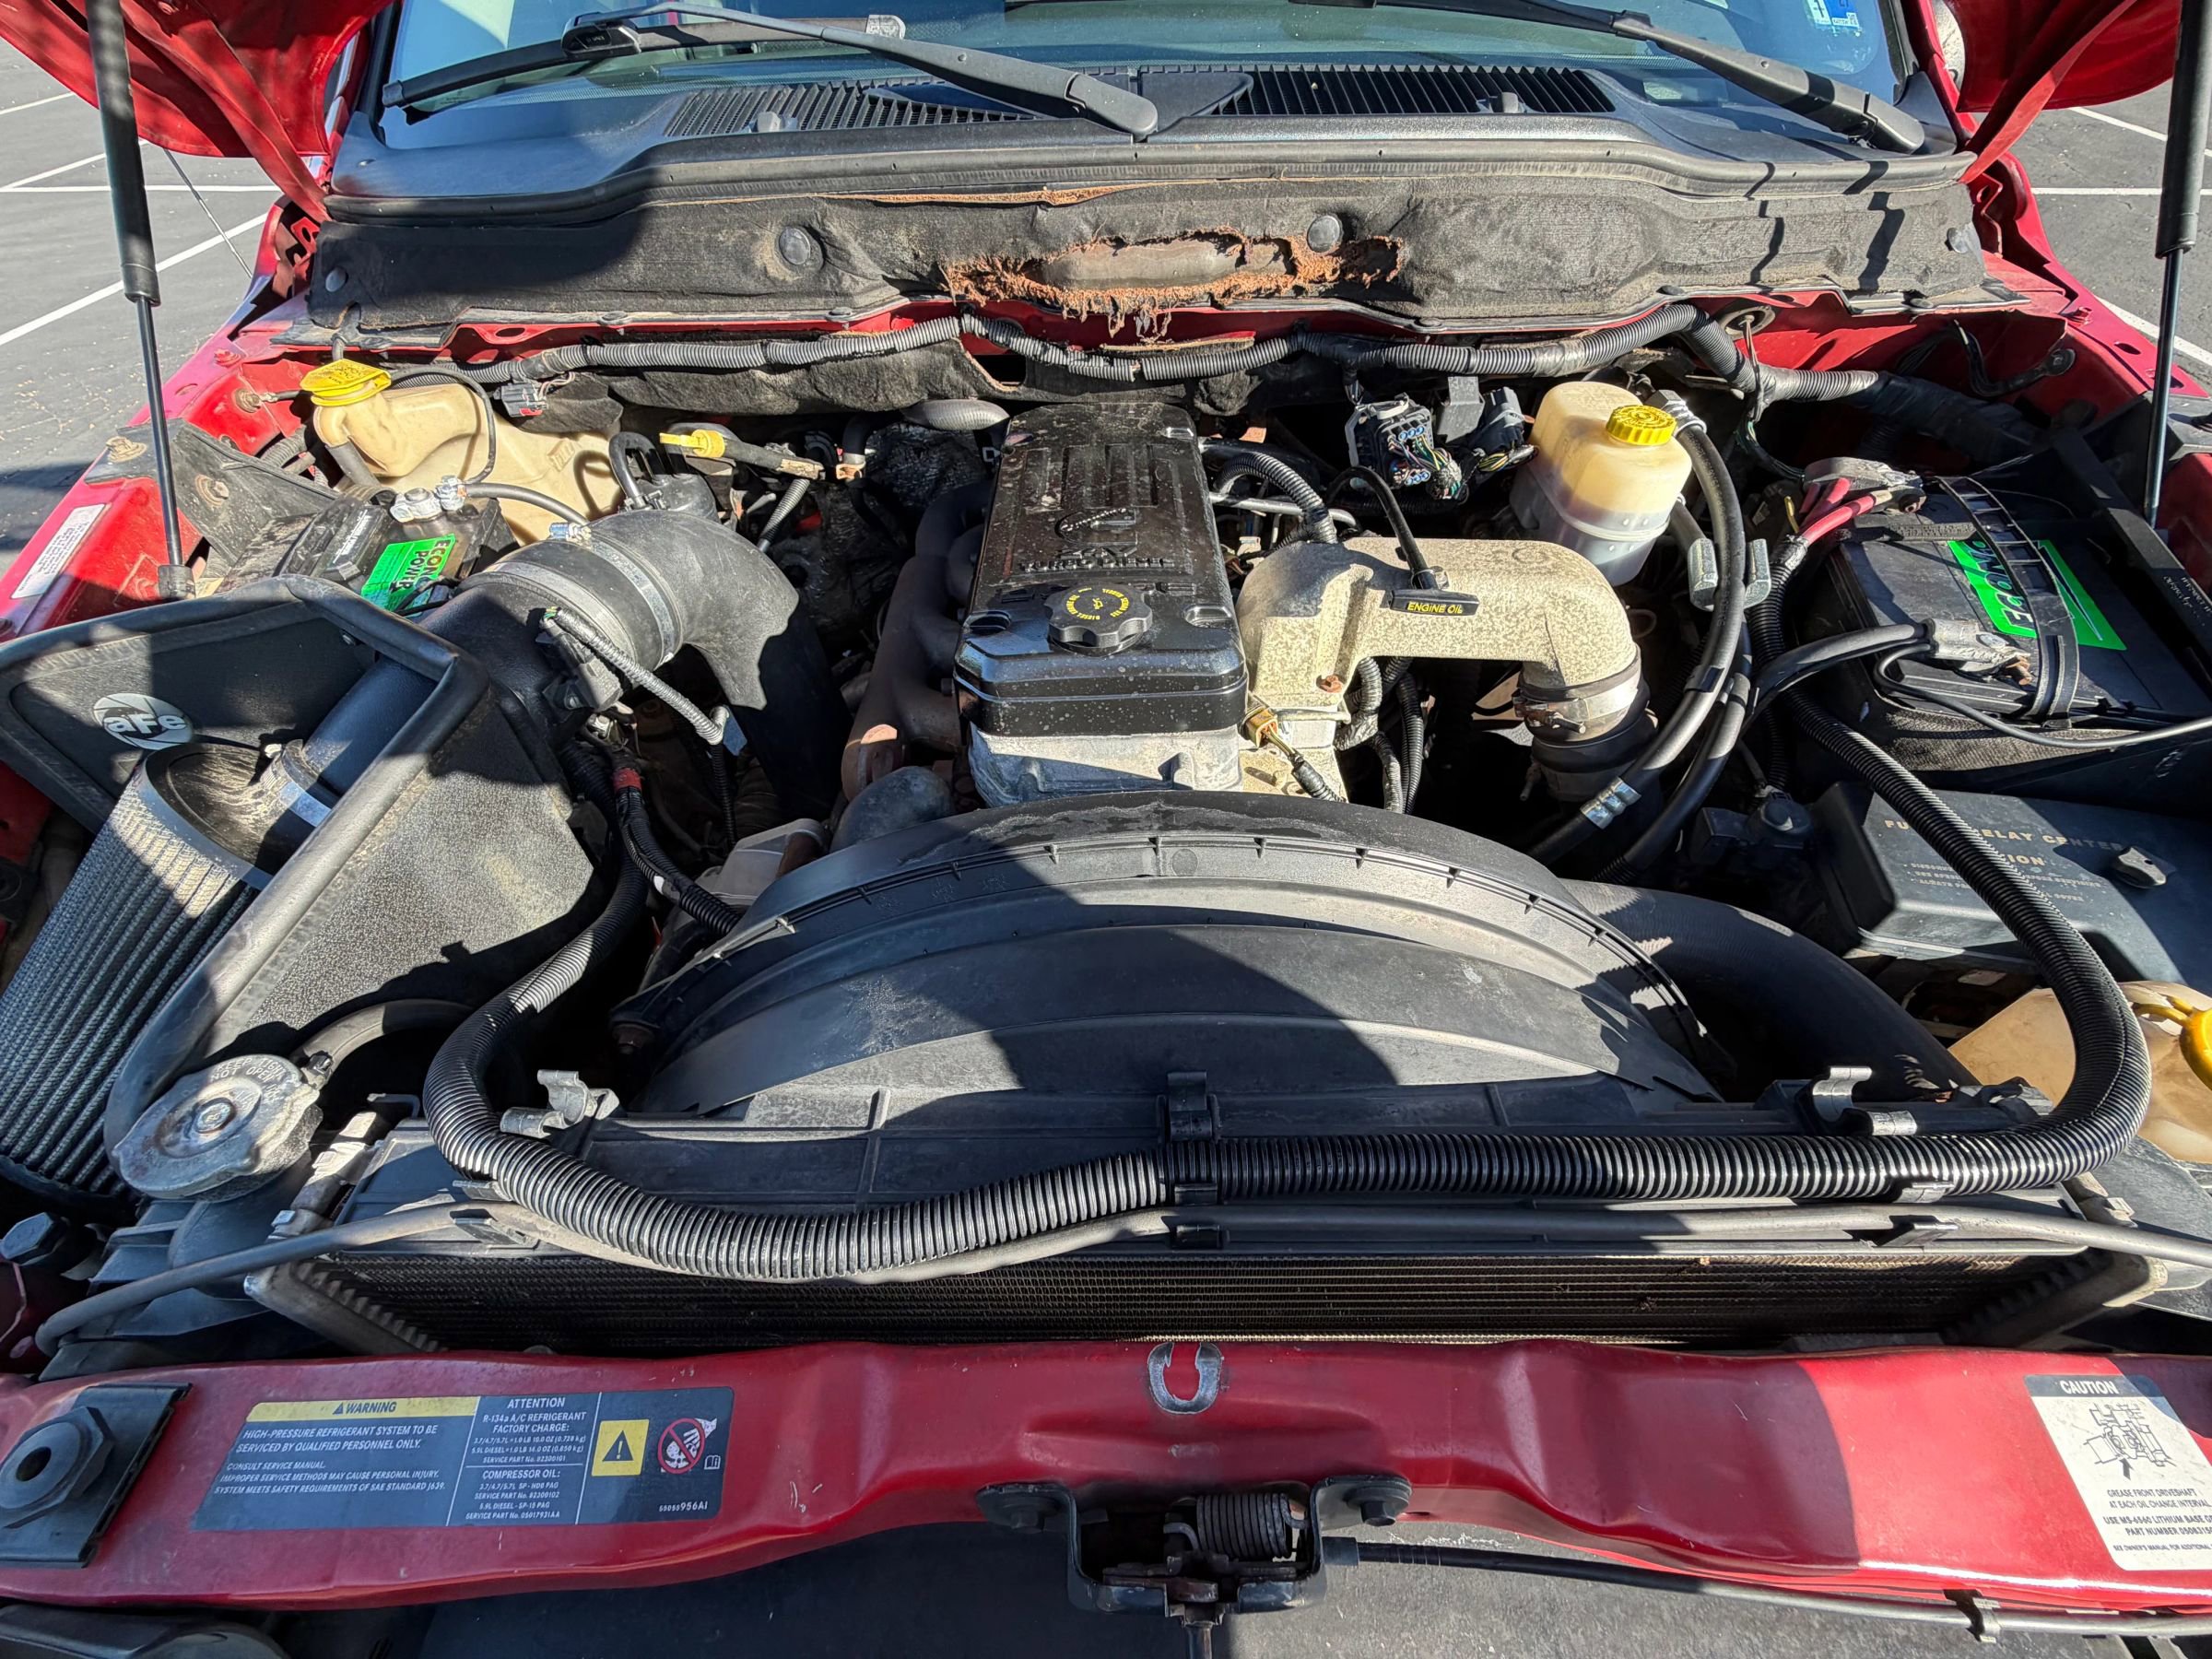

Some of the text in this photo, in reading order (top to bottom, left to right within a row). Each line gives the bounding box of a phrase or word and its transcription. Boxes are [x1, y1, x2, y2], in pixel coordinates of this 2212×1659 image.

[396, 550, 429, 588] POWER
[1406, 601, 1464, 614] ENGINE OIL
[103, 713, 187, 735] aFe
[210, 1067, 241, 1082] NOT
[246, 1066, 275, 1082] OPEN
[216, 1057, 286, 1081] KEEP TIGHT
[2059, 1380, 2120, 1394] CAUTION
[346, 1401, 397, 1414] WARNING
[507, 1397, 566, 1409] ATTENTION
[483, 1412, 586, 1423] R-134a A/C REFRIGERANT
[243, 1425, 439, 1439] HIGH-PRESSURE REFRIGERANT SYSTEM TO BE
[493, 1423, 570, 1434] FACTORY CHARGE:
[236, 1439, 421, 1453] SERVICED BY QUALIFIED PERSONNEL ONLY.
[227, 1462, 262, 1471] CONSULT
[262, 1462, 294, 1470] SERVICE
[220, 1474, 260, 1483] IMPROPER
[260, 1474, 291, 1482] SERVICE
[291, 1473, 328, 1481] METHODS
[346, 1471, 371, 1480] CAUSE
[371, 1471, 410, 1479] PERSONAL
[482, 1469, 560, 1479] COMPRESSOR OIL:
[214, 1486, 245, 1494] SYSTEM
[245, 1485, 272, 1494] MEETS
[271, 1485, 300, 1493] SAFETY
[300, 1483, 358, 1493] REQUIREMENTS
[358, 1483, 369, 1491] OF
[370, 1483, 384, 1491] SAE
[385, 1482, 427, 1491] STANDARD
[2107, 1488, 2197, 1498] GREASE FRONT DRIVESHAFT
[475, 1492, 499, 1500] SERVICE
[500, 1491, 516, 1500] PART
[2109, 1500, 2118, 1509] AT
[2118, 1500, 2136, 1509] EACH
[2136, 1500, 2150, 1508] OIL
[2148, 1500, 2179, 1508] CHANGE
[2103, 1516, 2121, 1524] USE
[2152, 1515, 2184, 1524] LITHIUM
[2183, 1515, 2206, 1524] BASE
[2125, 1527, 2146, 1535] PART
[2145, 1527, 2179, 1535] NUMBER
